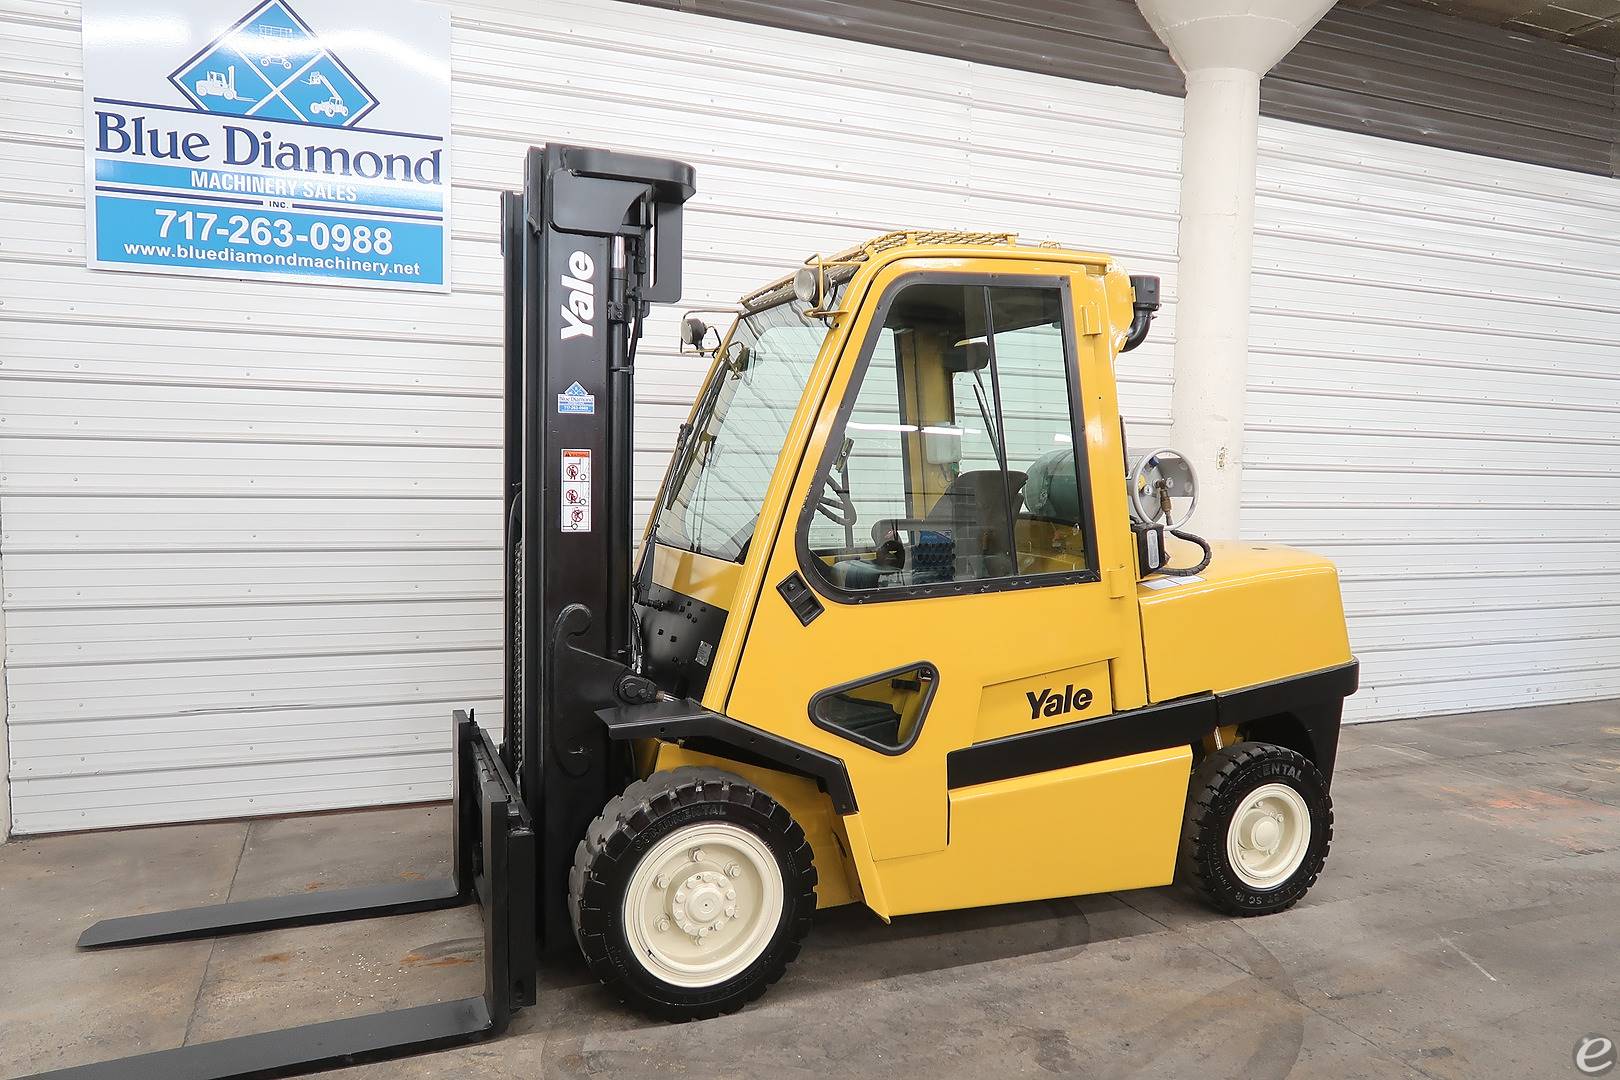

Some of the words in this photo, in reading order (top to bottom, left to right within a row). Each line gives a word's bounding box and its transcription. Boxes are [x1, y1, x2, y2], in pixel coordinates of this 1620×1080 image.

[95, 111, 210, 162] Blue
[222, 125, 443, 185] Diamond
[191, 170, 297, 197] MACHINERY
[303, 180, 358, 202] SALES
[269, 200, 289, 209] INC.
[155, 208, 393, 256] 717-263-0988
[124, 243, 421, 276] www.bluediamondmachinery.net
[561, 250, 595, 340] Yale
[1026, 684, 1093, 720] Yale
